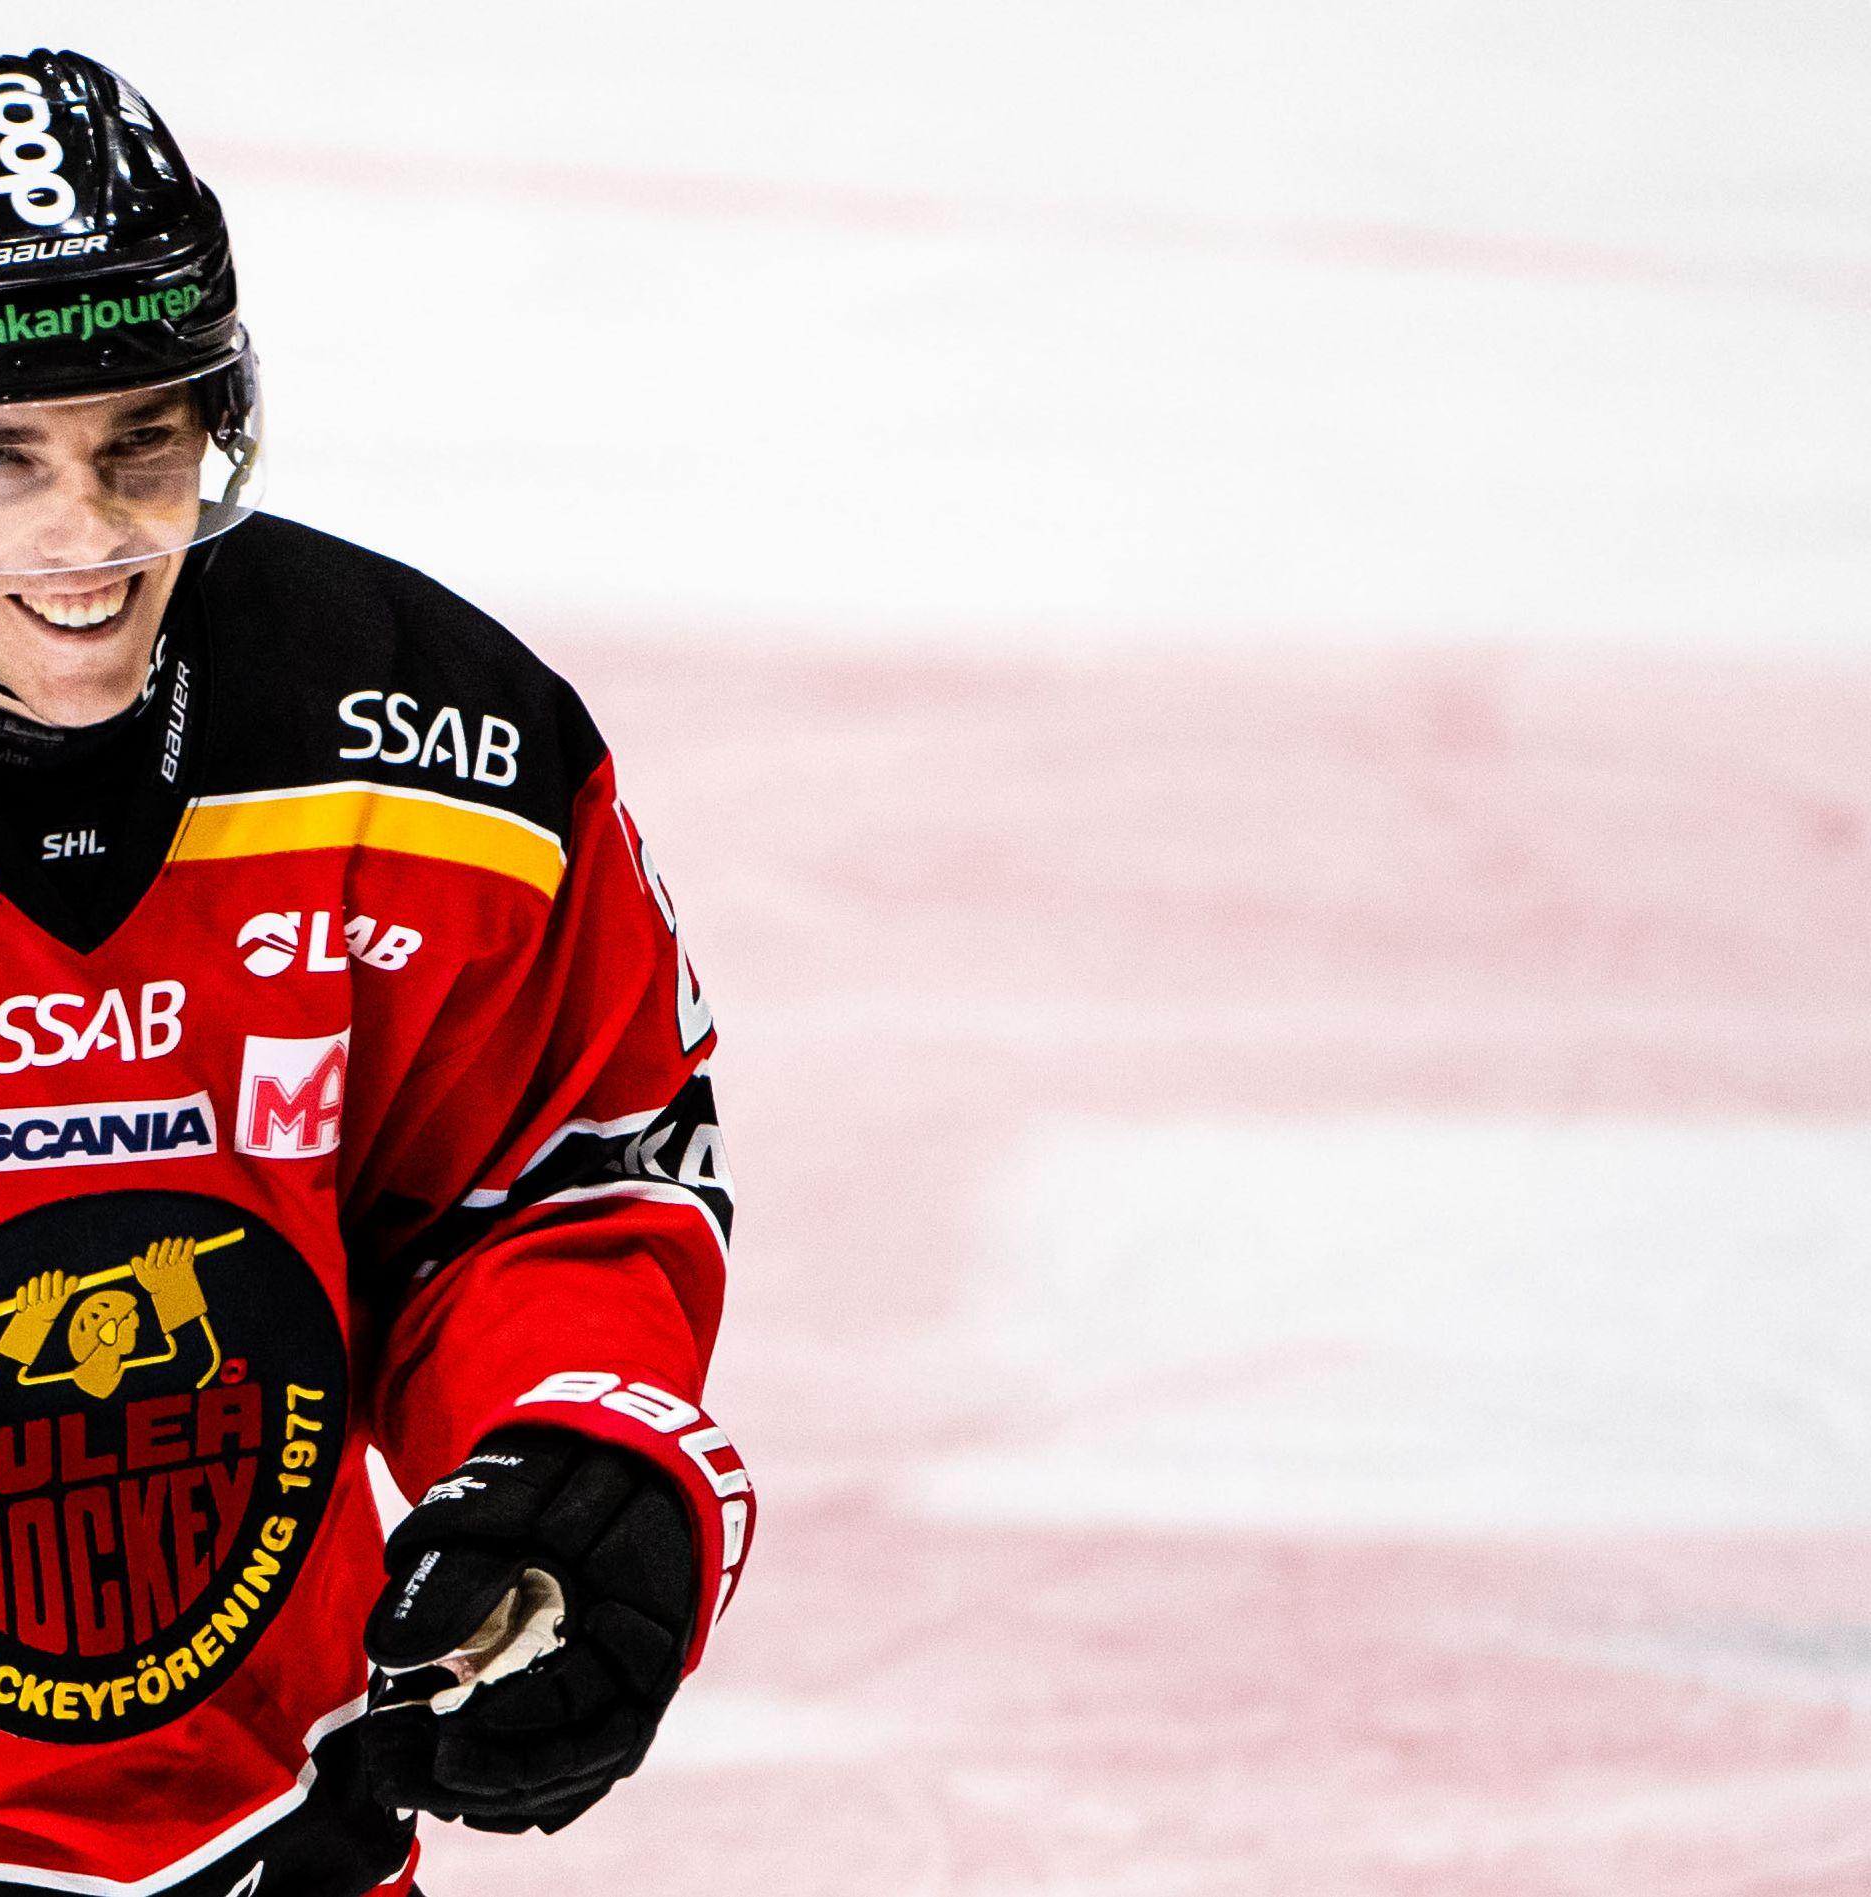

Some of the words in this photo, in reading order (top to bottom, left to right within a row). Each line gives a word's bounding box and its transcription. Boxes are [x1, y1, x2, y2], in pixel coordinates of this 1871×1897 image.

[337, 690, 521, 787] SSAB
[41, 829, 106, 861] SHL
[306, 911, 423, 972] LAB
[246, 1040, 350, 1151] MA
[277, 1383, 325, 1494] 1977
